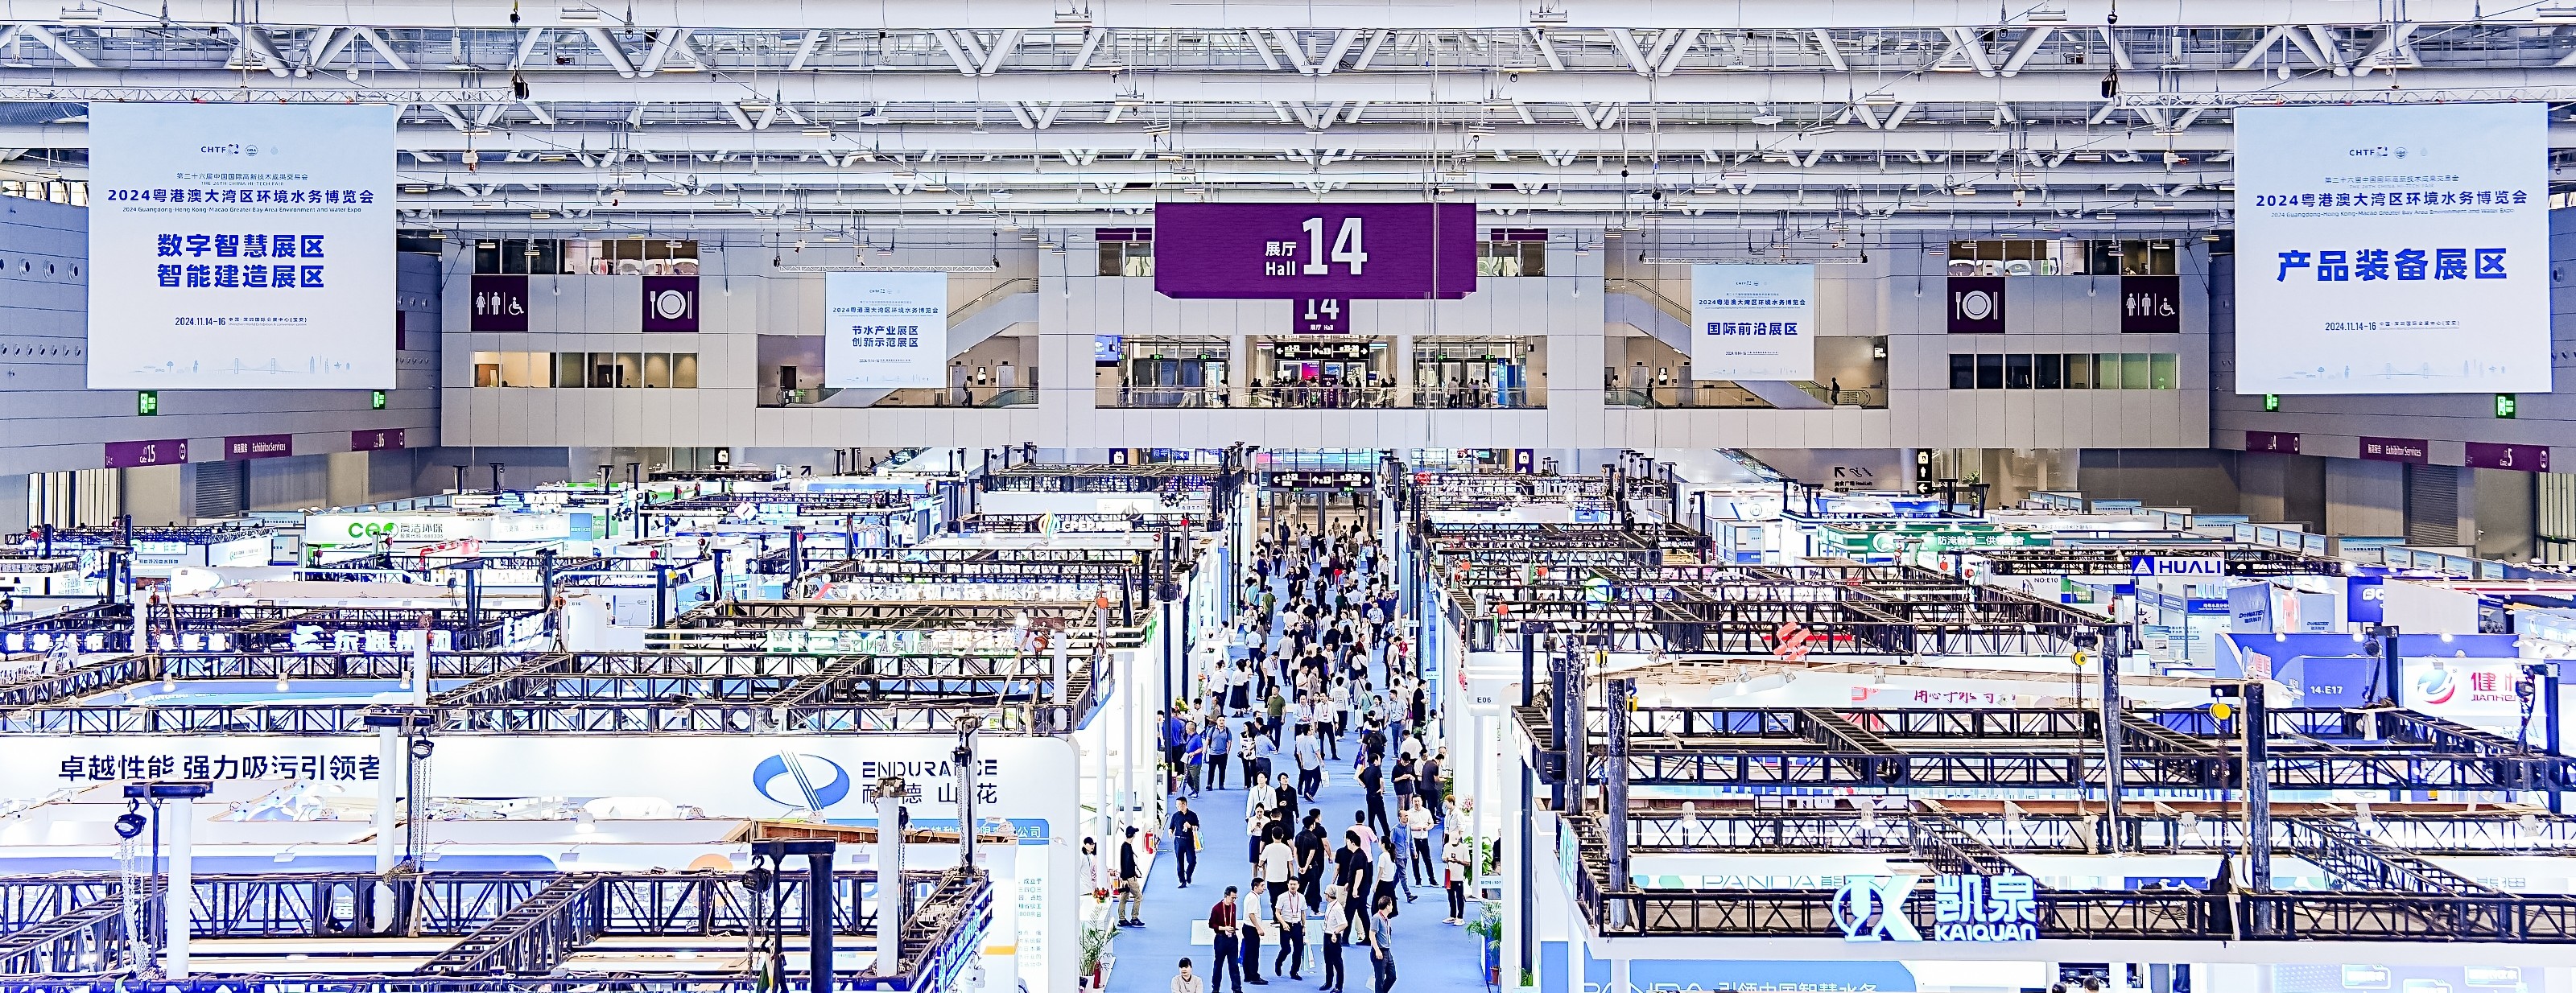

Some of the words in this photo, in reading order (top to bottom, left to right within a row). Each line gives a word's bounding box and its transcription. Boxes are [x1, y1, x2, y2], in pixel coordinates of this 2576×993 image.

[107, 188, 374, 204] 2024粤港澳大湾区环境水务博览会
[2256, 189, 2528, 208] 2024粤港澳大湾区环境水务博览会
[157, 233, 324, 258] 数字智慧展区
[1265, 241, 1297, 257] 展厅
[1302, 217, 1368, 276] 14
[1265, 261, 1296, 276] Hall
[2277, 247, 2508, 282] 产品装备展区
[157, 263, 324, 289] 智能建造展区
[1304, 299, 1340, 319] 14
[175, 317, 226, 326] 2024.11.14-16
[1707, 322, 1798, 336] 国际前沿展区
[2325, 321, 2376, 331] 2024.11.14-16
[852, 325, 919, 336] 节水产业展区
[852, 337, 919, 347] 创新示范展区
[252, 443, 270, 453] Exhibitor
[270, 442, 286, 451] Services
[378, 432, 385, 447] 16
[147, 444, 155, 463] 15
[2404, 446, 2421, 457] Services
[2508, 447, 2512, 466] 5
[2159, 560, 2221, 574] HUALI
[58, 755, 175, 781] 卓越性能
[183, 754, 380, 781] 强力吸污引领者
[862, 759, 997, 778] ENDURACE
[1703, 875, 1816, 889] PANDA
[1934, 873, 2037, 923] 凯泉
[1934, 923, 2037, 941] KAIQUAN
